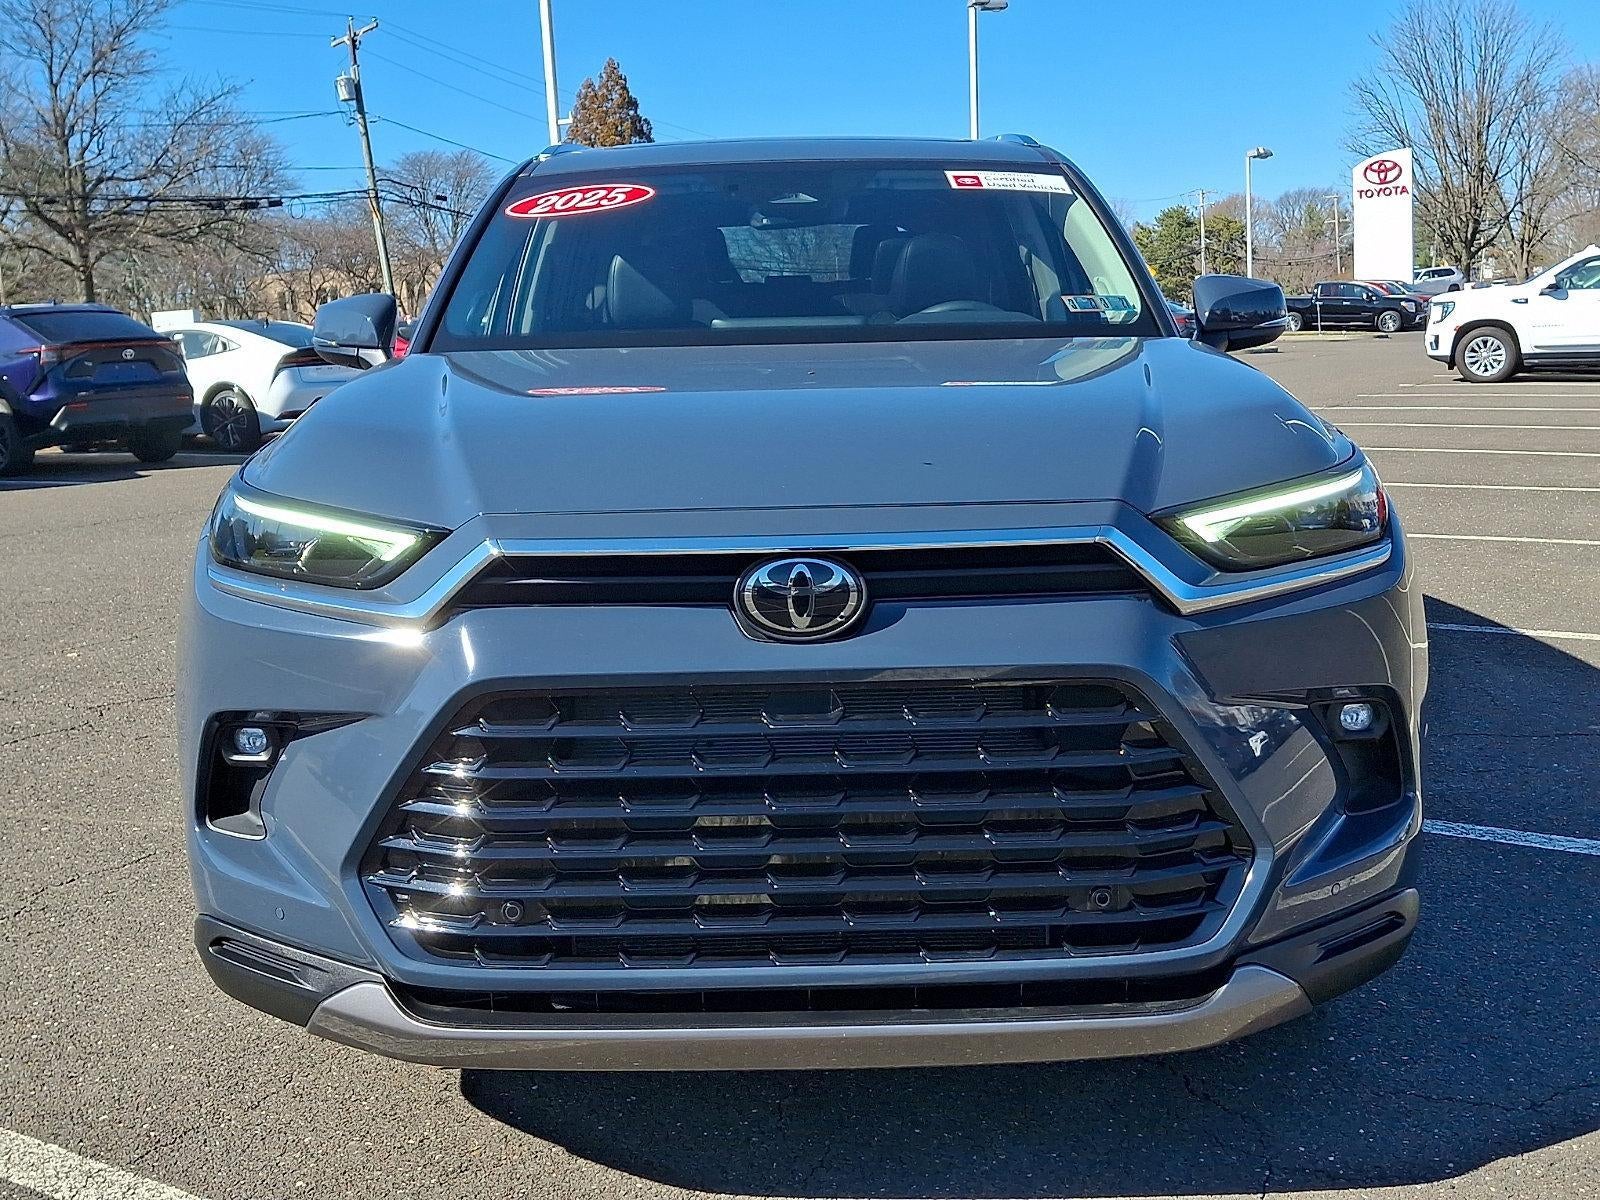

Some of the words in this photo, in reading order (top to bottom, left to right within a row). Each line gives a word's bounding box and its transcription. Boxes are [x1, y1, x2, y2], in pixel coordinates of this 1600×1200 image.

[1020, 183, 1066, 192] Vehicles
[1357, 186, 1409, 199] TOYOTA
[528, 187, 634, 215] 2025
